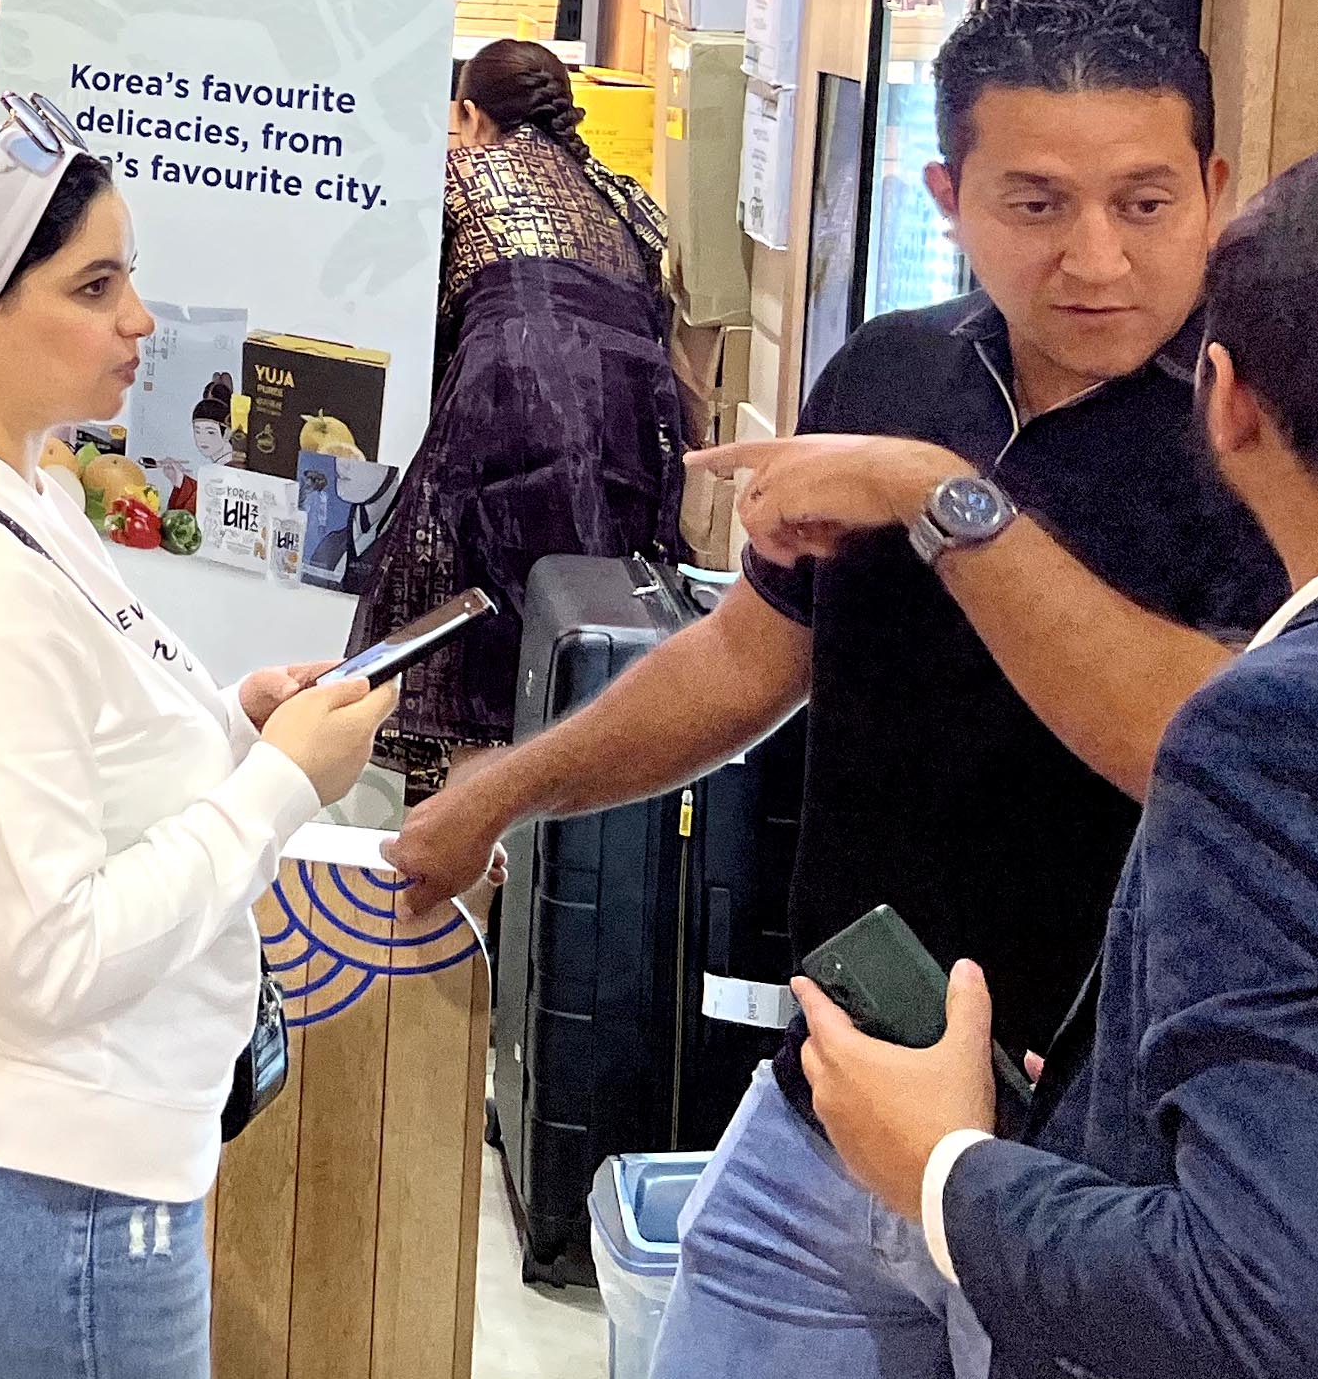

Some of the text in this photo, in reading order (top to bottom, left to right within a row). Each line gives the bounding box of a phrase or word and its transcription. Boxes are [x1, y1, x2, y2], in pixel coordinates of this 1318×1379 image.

[70, 63, 356, 114] Korea's favourite
[76, 106, 343, 157] delicacies, from
[151, 154, 303, 196] favourite
[315, 173, 388, 211] city.
[254, 364, 295, 388] YUJA
